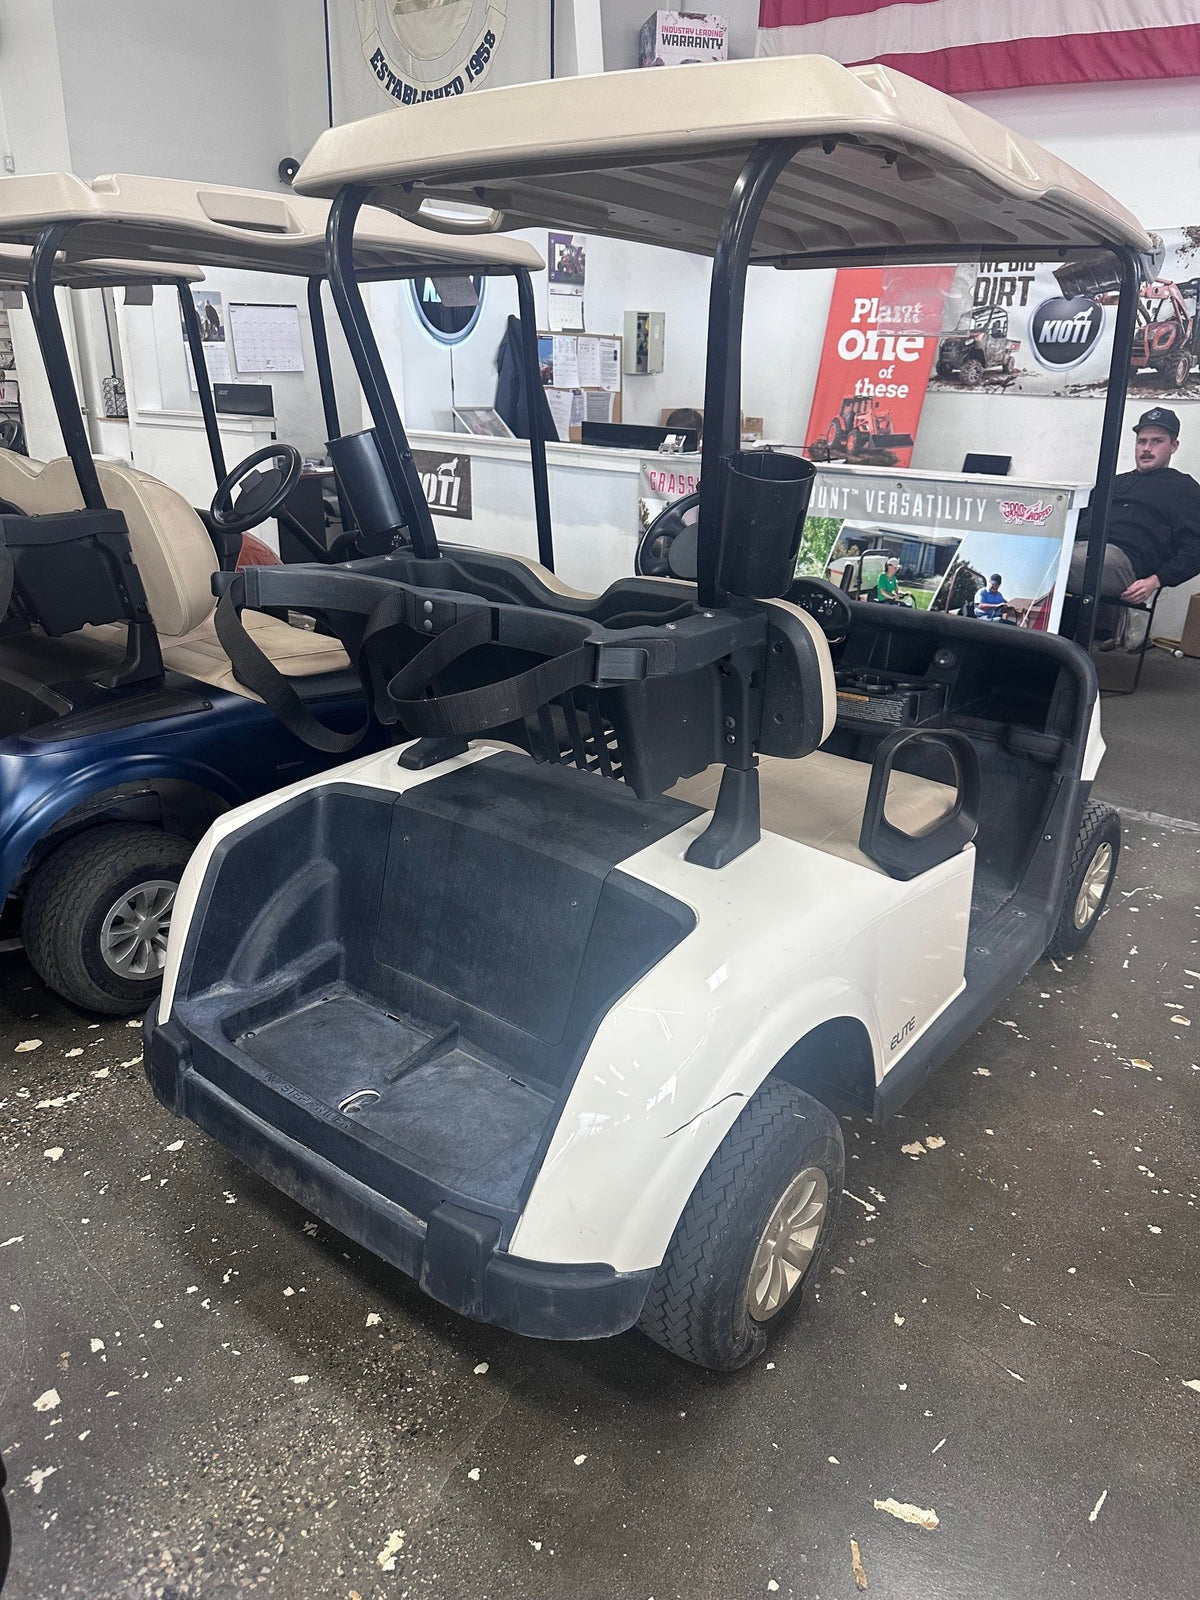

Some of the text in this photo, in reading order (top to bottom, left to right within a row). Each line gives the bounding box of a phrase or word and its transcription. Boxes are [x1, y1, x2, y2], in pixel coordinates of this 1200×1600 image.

[661, 25, 724, 38] INDUSTRY LEADING
[661, 33, 724, 50] WARRANTY
[369, 29, 496, 106] ESTABLISHED 1958
[973, 276, 1036, 307] DIRT
[850, 297, 924, 324] Plant
[1038, 319, 1093, 344] KIOTI
[837, 328, 925, 363] one
[878, 364, 896, 379] of
[854, 377, 910, 399] these
[649, 470, 700, 495] GRASS
[865, 489, 987, 523] VERSATILITY
[890, 1015, 916, 1051] ELITE
